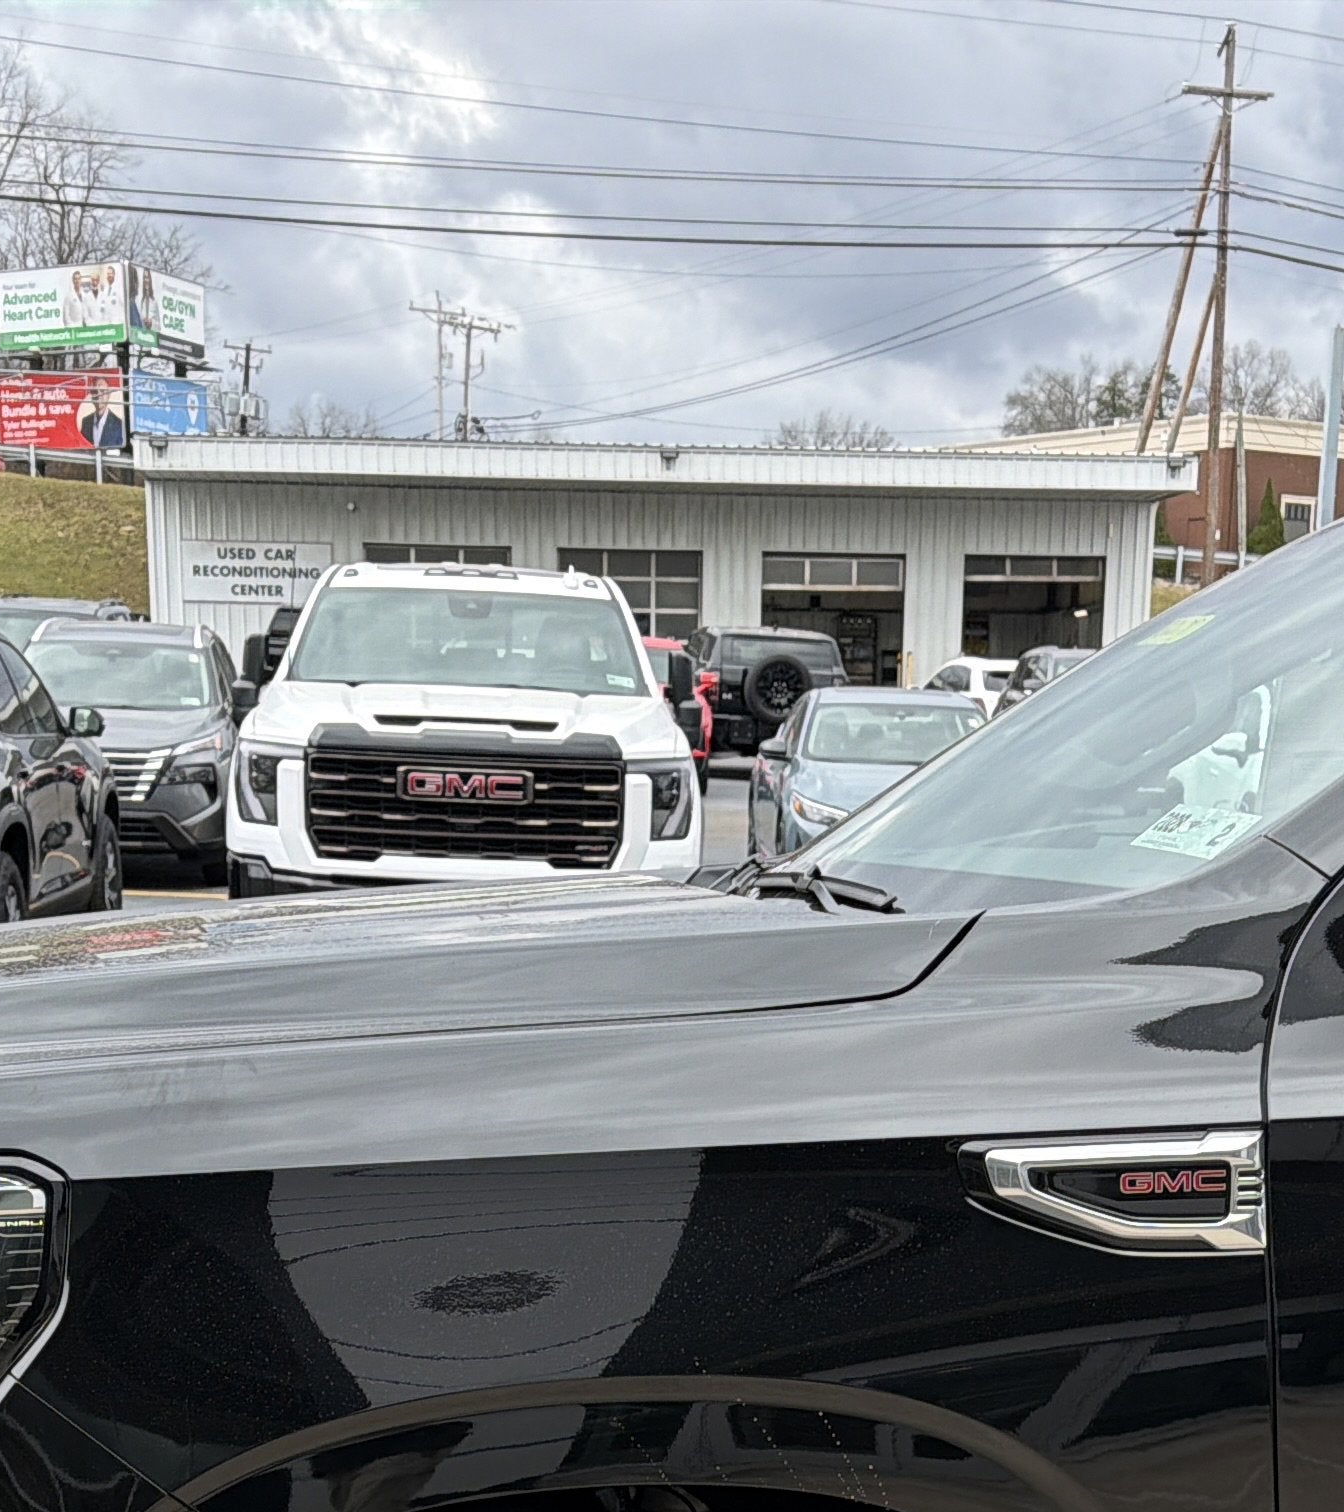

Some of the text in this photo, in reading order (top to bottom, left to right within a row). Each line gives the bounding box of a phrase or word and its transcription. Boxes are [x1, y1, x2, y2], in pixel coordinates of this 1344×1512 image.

[3, 289, 57, 305] Advanced
[3, 306, 61, 321] Heart Care
[162, 295, 196, 318] OB/GYN
[162, 313, 185, 333] CARE
[217, 547, 295, 561] USED CAR
[192, 564, 321, 579] RECONDITIONING
[231, 584, 284, 597] CENTER
[407, 771, 524, 800] GMC
[1119, 1169, 1228, 1195] GMC
